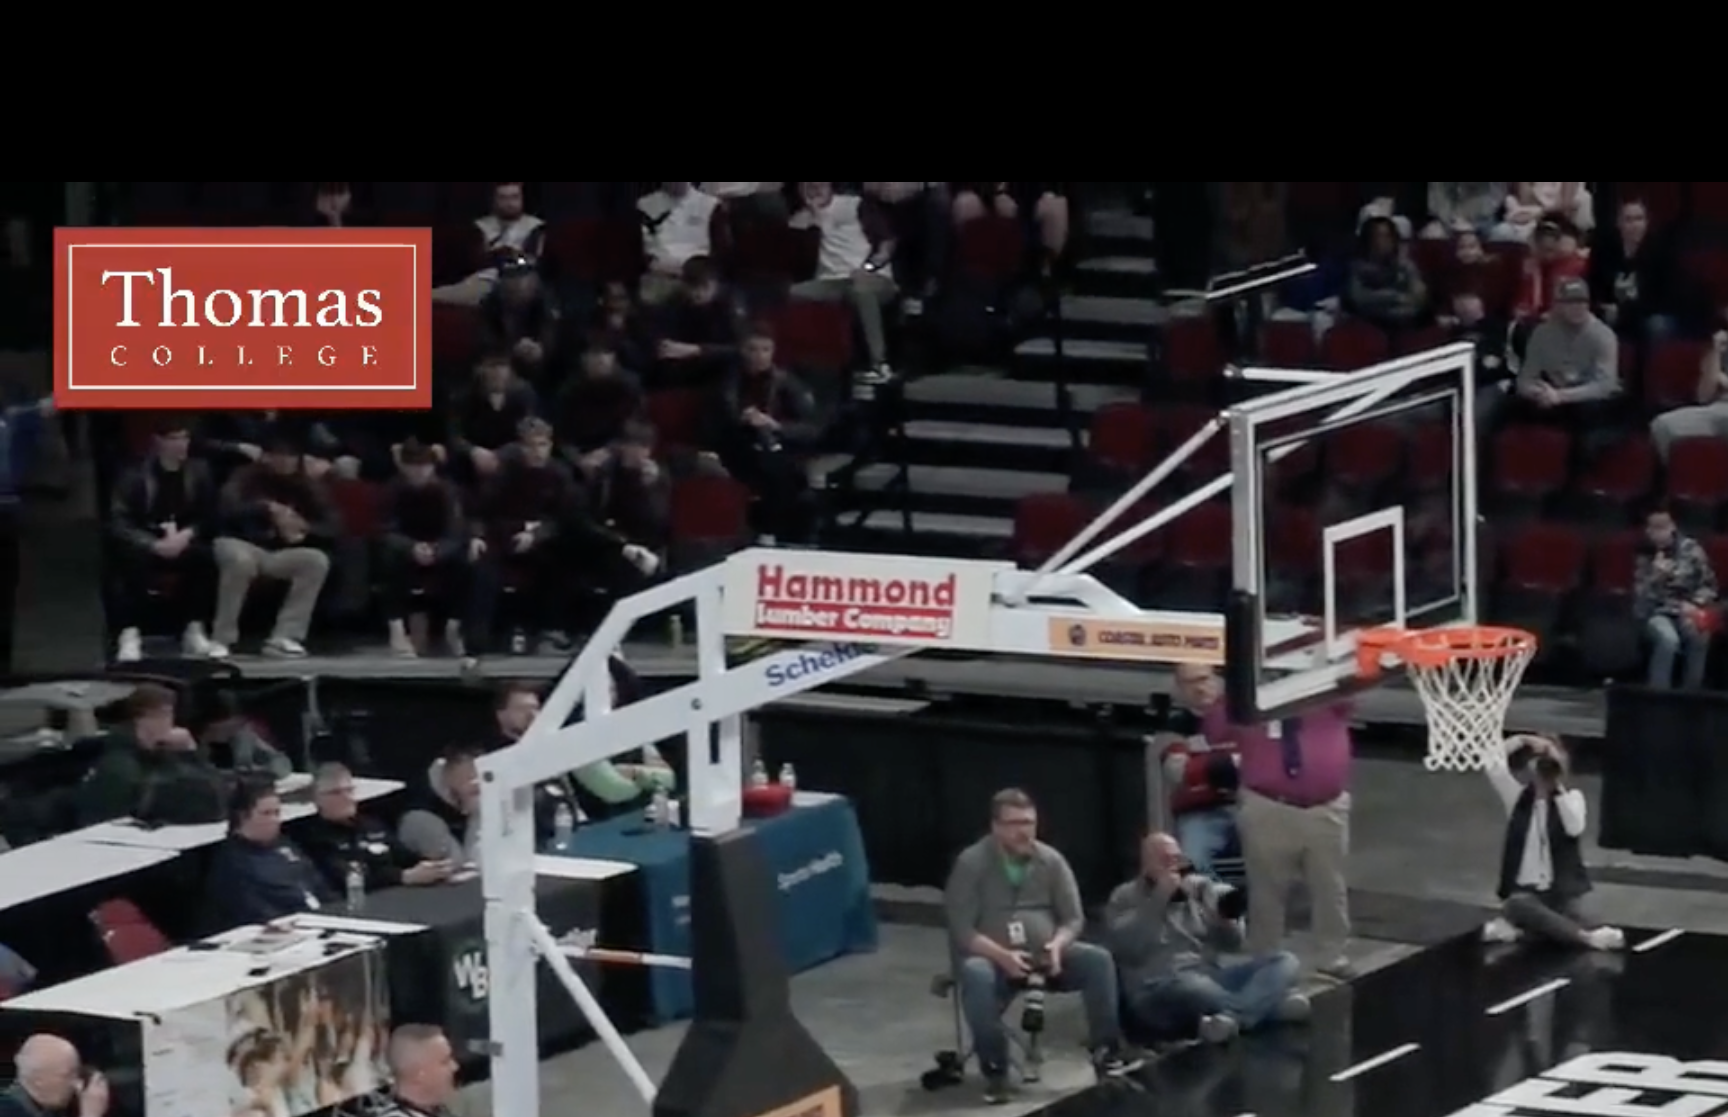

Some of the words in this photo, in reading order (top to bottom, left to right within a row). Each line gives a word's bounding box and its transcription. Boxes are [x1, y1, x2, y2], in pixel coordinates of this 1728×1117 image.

[758, 565, 955, 606] Hammond
[756, 602, 839, 627] Lumber
[843, 608, 951, 639] Company
[1098, 630, 1144, 645] COASTAL
[1150, 633, 1181, 648] AUTO
